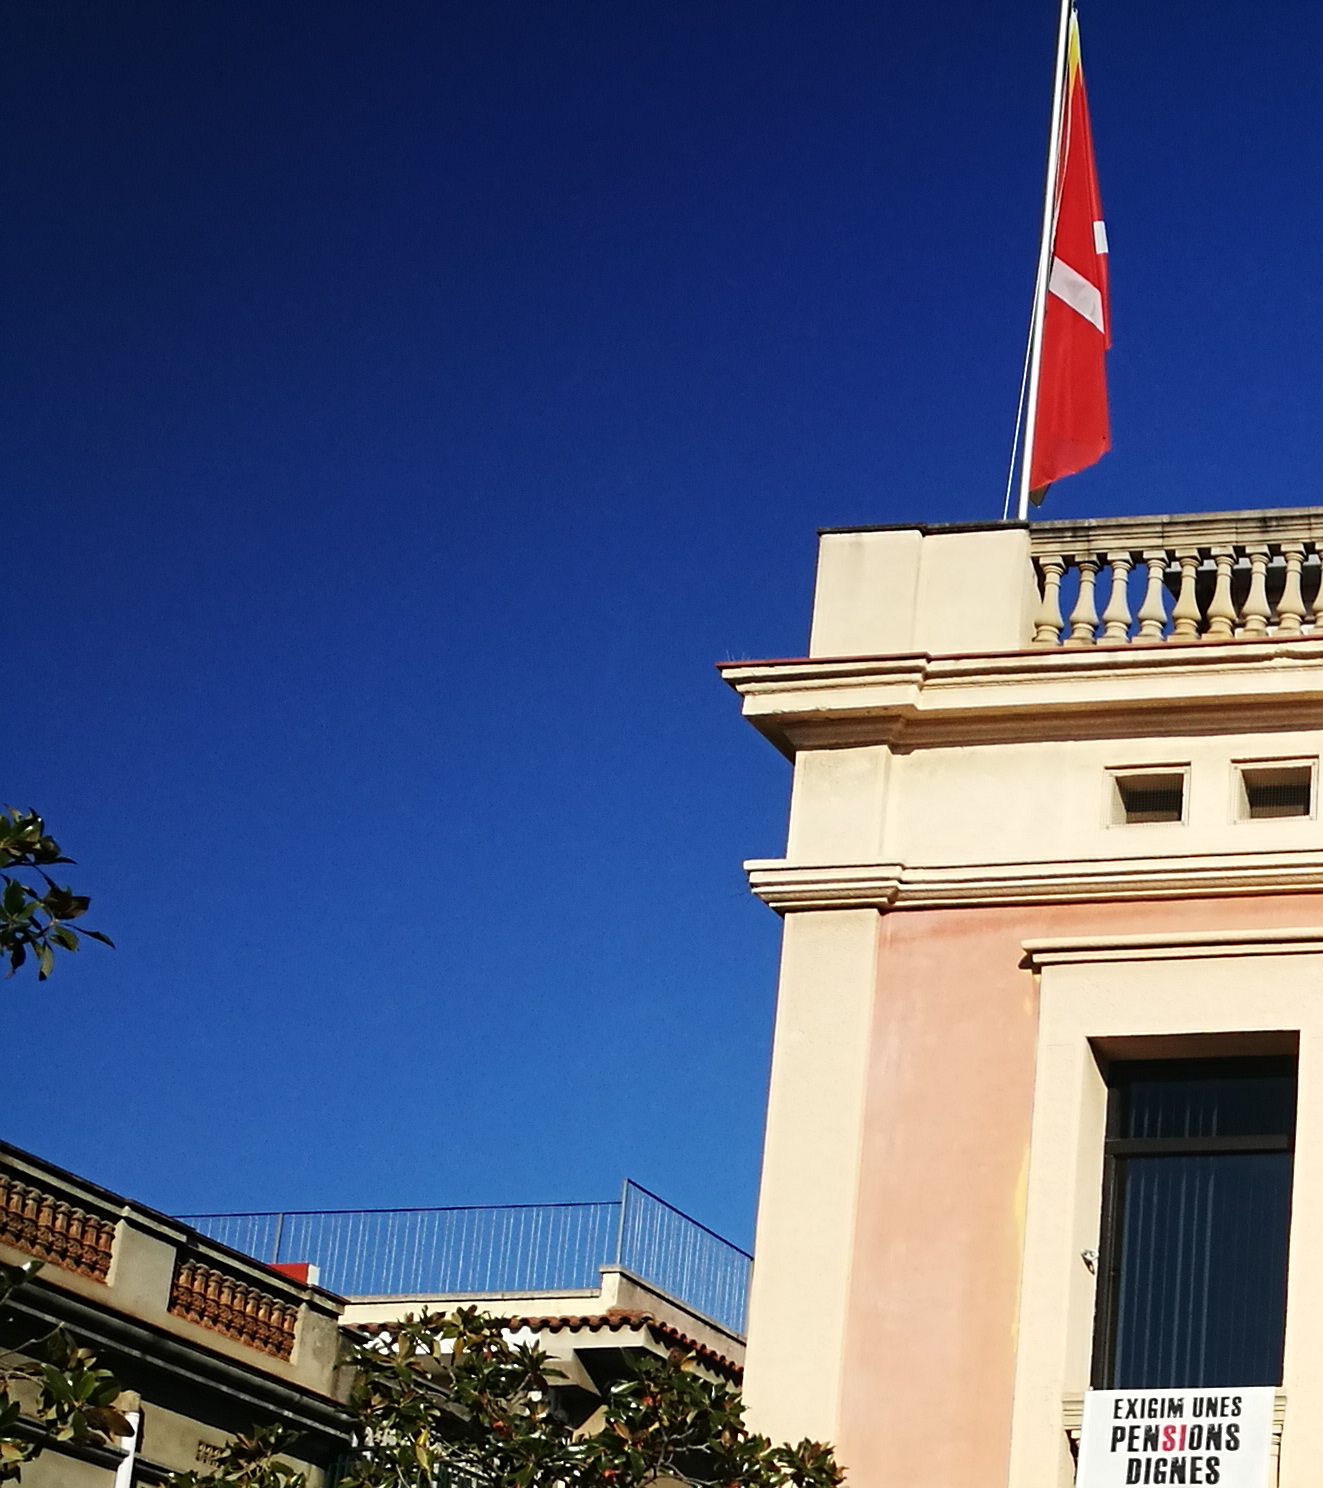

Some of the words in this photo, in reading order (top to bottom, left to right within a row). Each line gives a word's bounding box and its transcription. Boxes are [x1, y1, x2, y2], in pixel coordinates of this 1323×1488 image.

[1113, 1397, 1184, 1419] EXIGIM
[1192, 1396, 1242, 1418] UNES
[1110, 1423, 1241, 1452] PENSIONS
[1126, 1456, 1220, 1485] DIGNES
